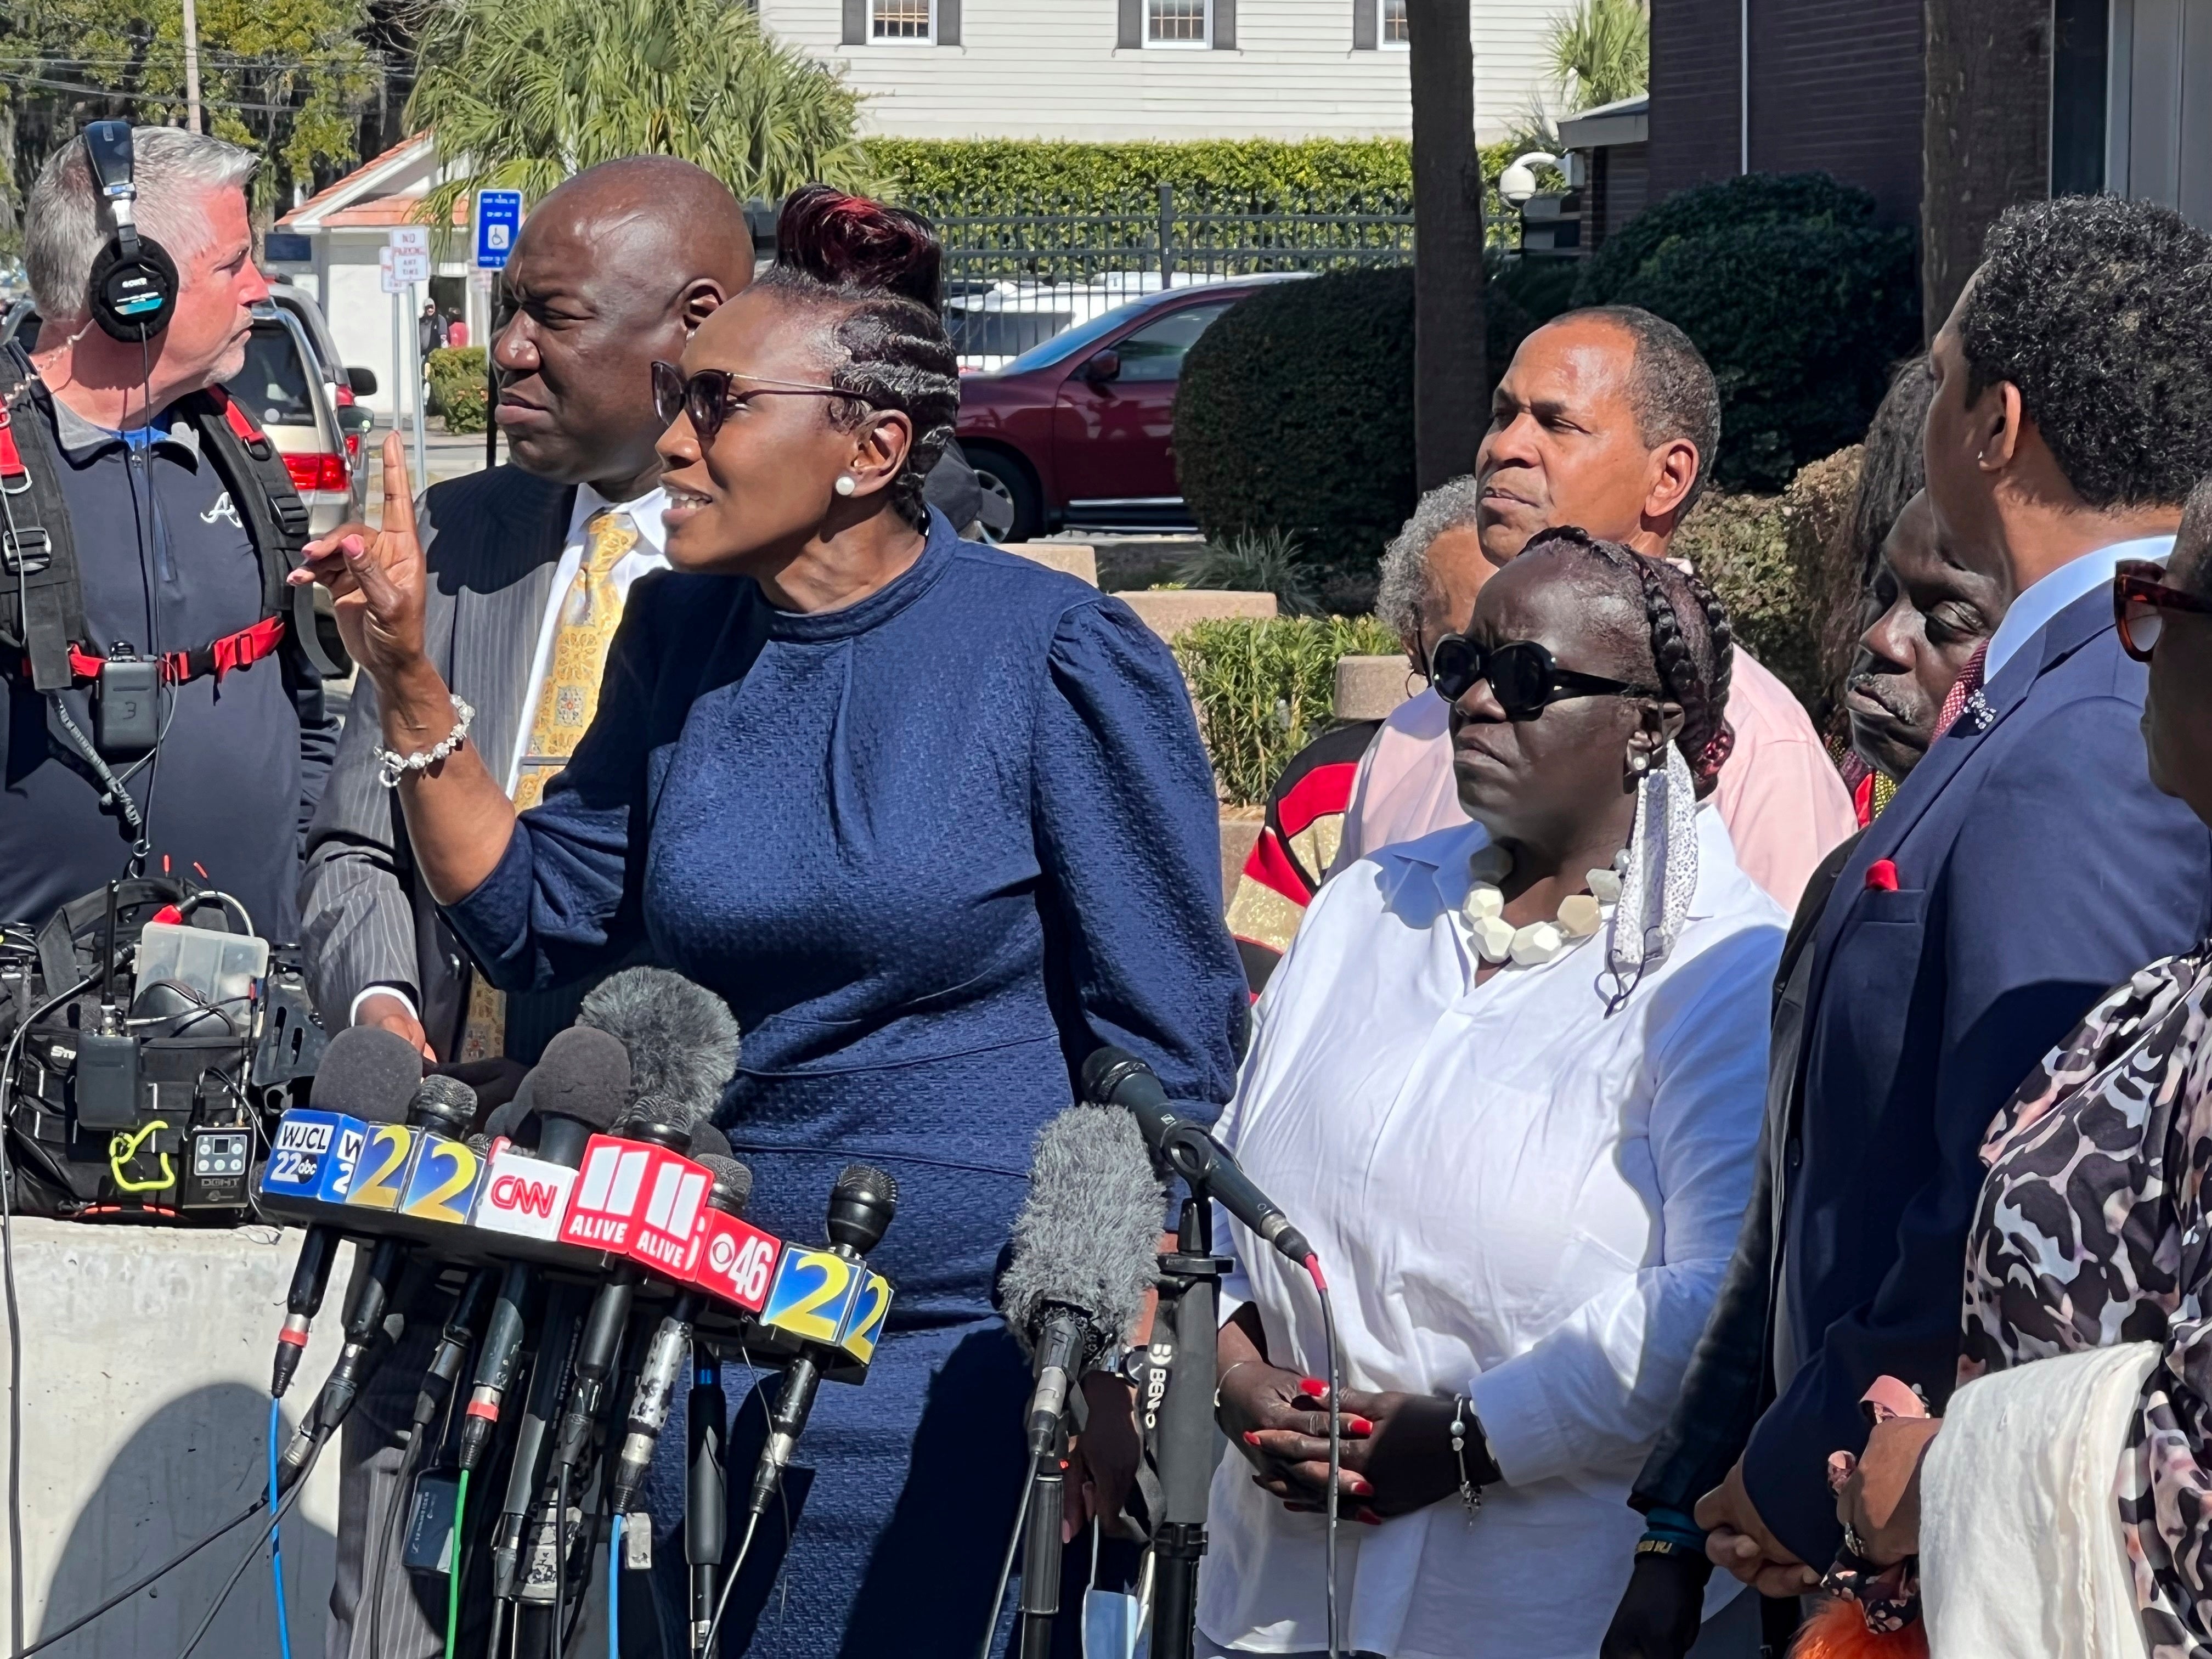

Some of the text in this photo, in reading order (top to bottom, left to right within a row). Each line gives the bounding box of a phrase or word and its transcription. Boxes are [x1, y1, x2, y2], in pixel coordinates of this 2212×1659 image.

[122, 701, 137, 720] 3
[282, 1125, 326, 1150] WJCL
[270, 1151, 317, 1183] 22 abc
[346, 1125, 411, 1208] 2
[402, 1142, 477, 1224] 2
[490, 1175, 558, 1218] CNN
[568, 1215, 629, 1244] ALIVE
[636, 1229, 685, 1268] ALIVE
[727, 1235, 774, 1301] 46
[768, 1252, 850, 1341] 2
[842, 1276, 889, 1365] 2
